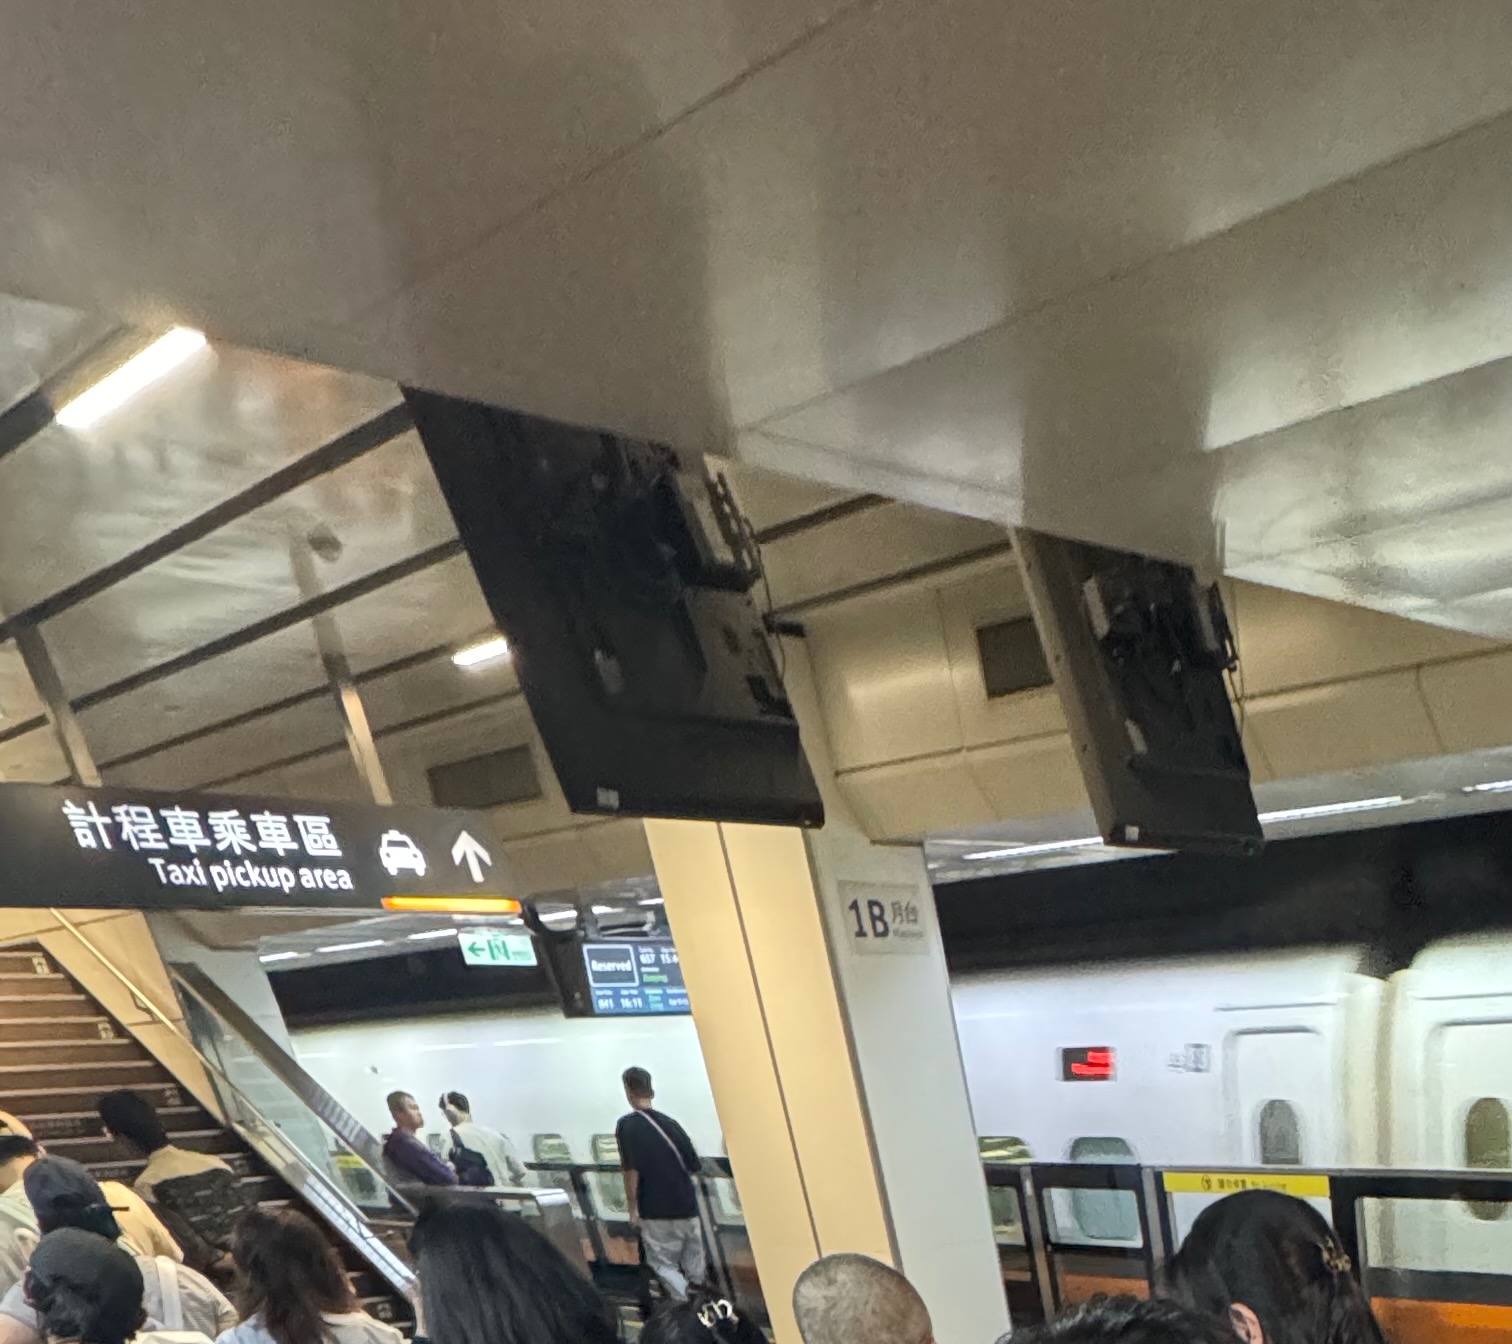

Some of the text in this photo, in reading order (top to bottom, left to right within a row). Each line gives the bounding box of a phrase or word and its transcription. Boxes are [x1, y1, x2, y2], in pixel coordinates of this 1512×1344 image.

[62, 799, 343, 857] 計程車乘車區
[148, 857, 354, 893] Taxi pickup area
[848, 897, 890, 938] 1B
[591, 959, 633, 972] Reserved
